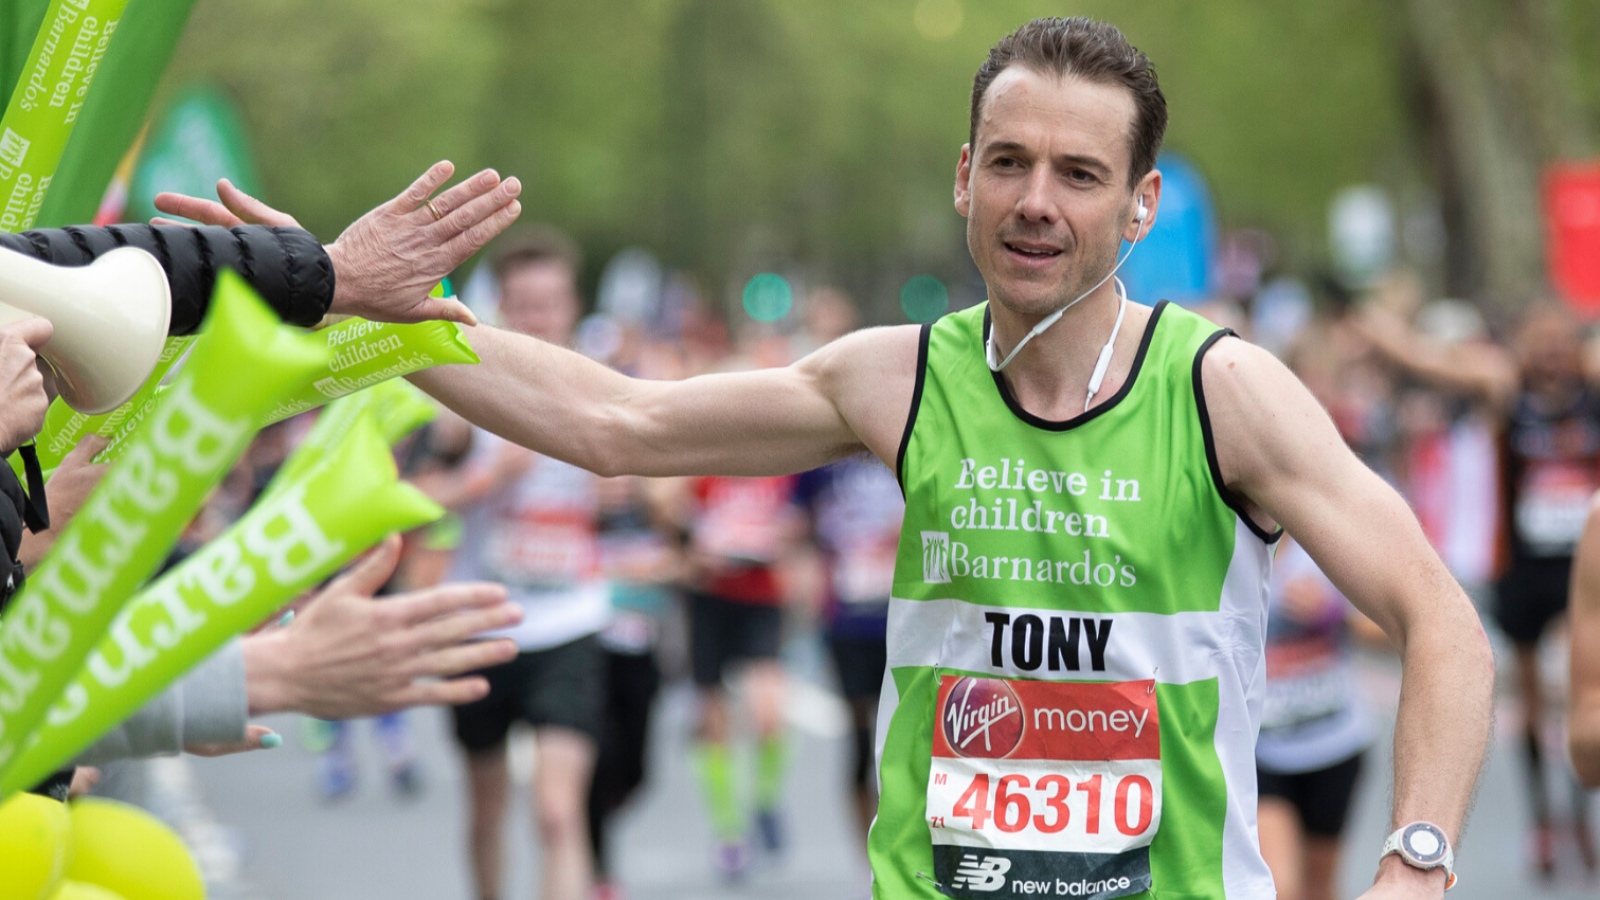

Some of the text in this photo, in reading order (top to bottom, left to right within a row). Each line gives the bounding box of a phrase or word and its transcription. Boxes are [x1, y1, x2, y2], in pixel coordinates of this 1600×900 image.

[20, 3, 80, 112] Barnardo's
[49, 16, 98, 108] children
[76, 19, 119, 99] Believe
[328, 334, 404, 373] children
[339, 351, 434, 393] Barnardo's
[96, 401, 134, 437] child
[954, 458, 1141, 501] Believe in
[950, 498, 1110, 538] children
[0, 374, 251, 766] Barnar
[951, 542, 1137, 587] Barnardo's
[984, 612, 1113, 672] TONY
[947, 678, 1149, 751] Virgin money
[934, 773, 948, 786] M
[952, 773, 1153, 836] 46310
[1012, 879, 1053, 895] new
[1055, 875, 1131, 896] balance
